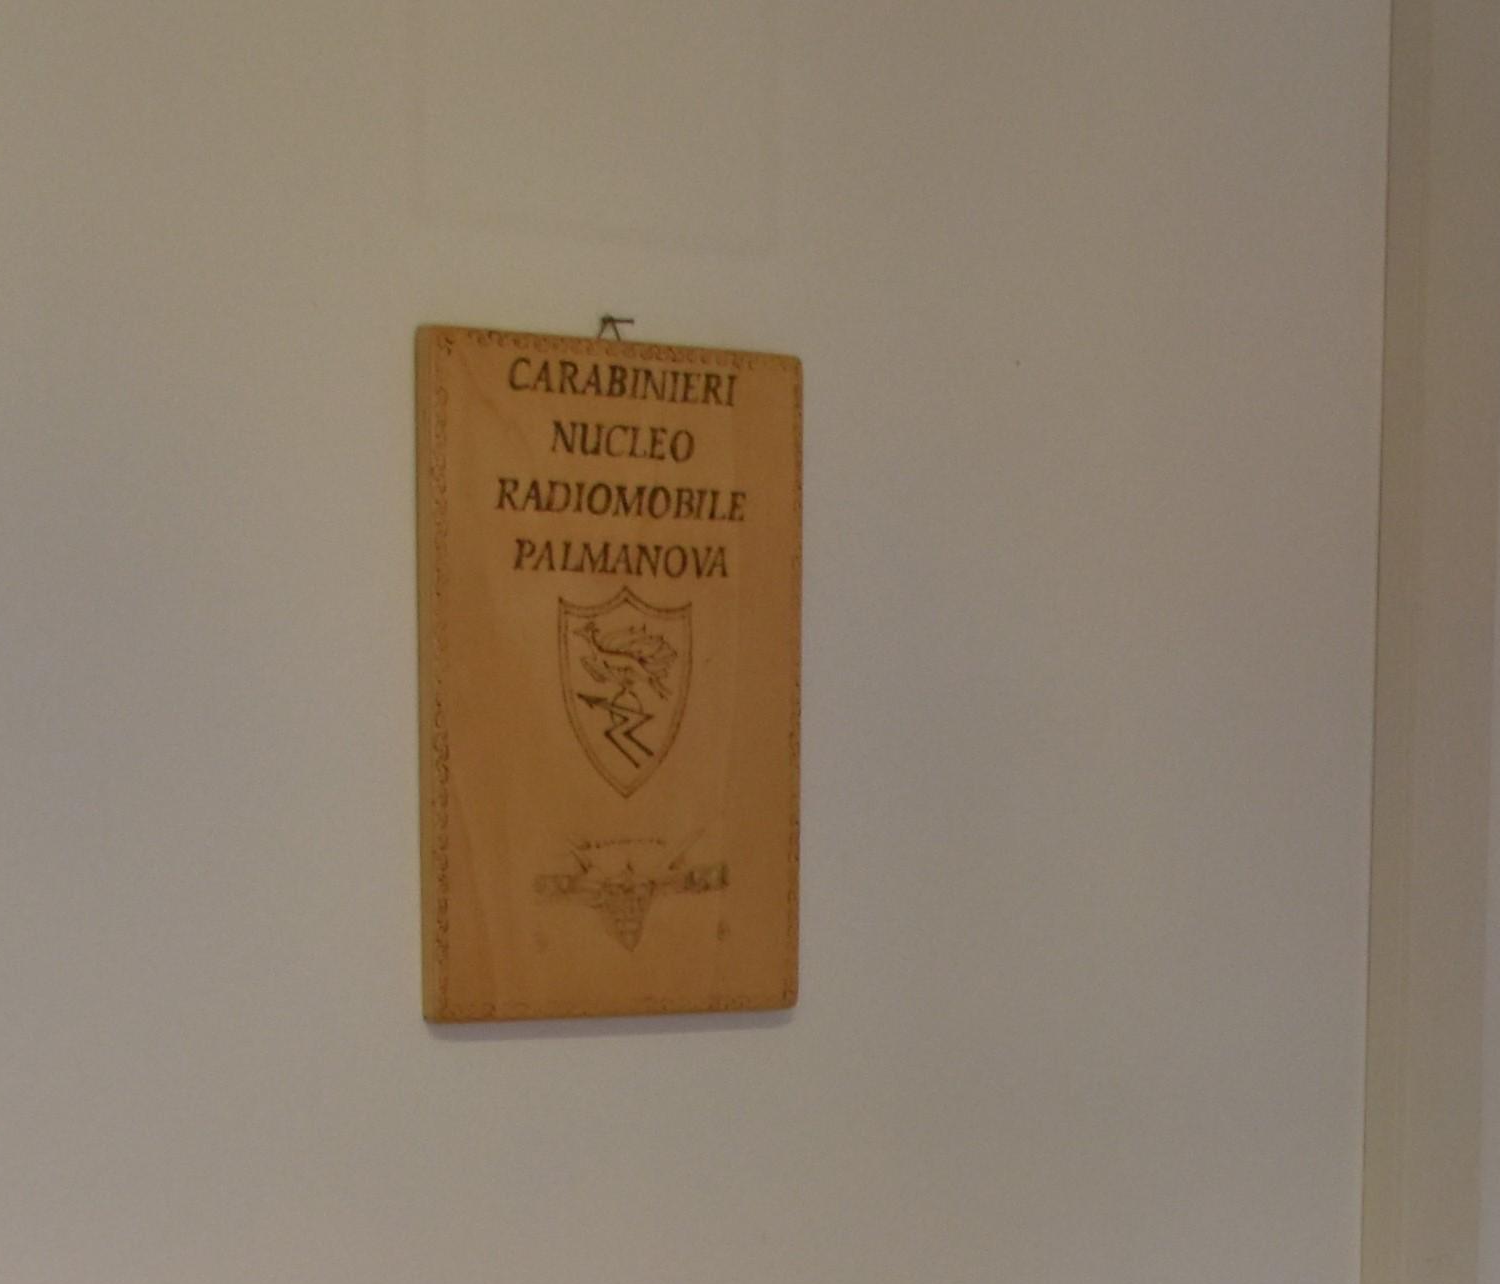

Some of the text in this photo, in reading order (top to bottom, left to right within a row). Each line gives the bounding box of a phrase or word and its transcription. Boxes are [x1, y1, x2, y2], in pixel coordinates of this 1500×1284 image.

[507, 356, 736, 408] CARABINIERI
[549, 420, 695, 464] NUCLEO
[495, 477, 747, 523] RADIOMOBILE
[512, 539, 730, 579] PALMANOVA
